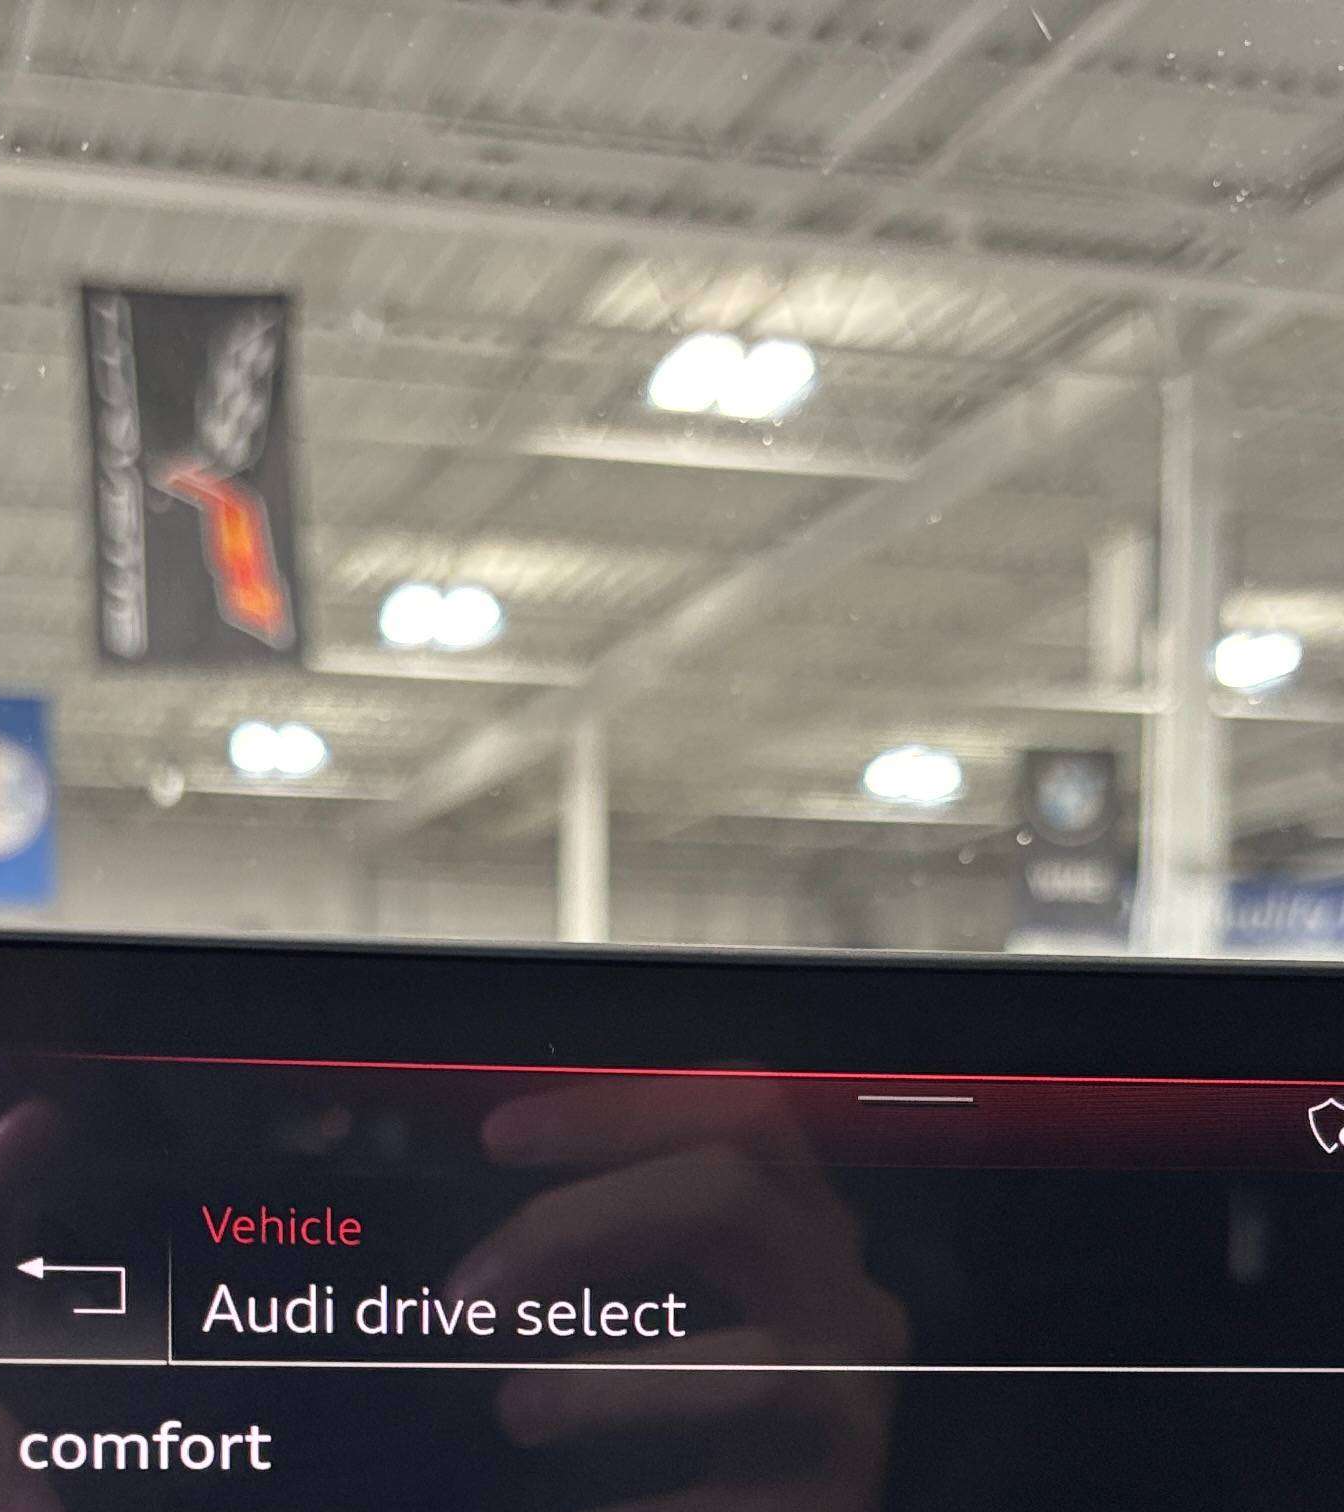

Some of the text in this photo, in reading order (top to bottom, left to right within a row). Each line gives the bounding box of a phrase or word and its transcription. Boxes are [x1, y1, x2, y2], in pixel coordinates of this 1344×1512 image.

[201, 1205, 363, 1247] Vehicle
[201, 1283, 688, 1338] Audi drive select
[18, 1420, 273, 1472] comfort
